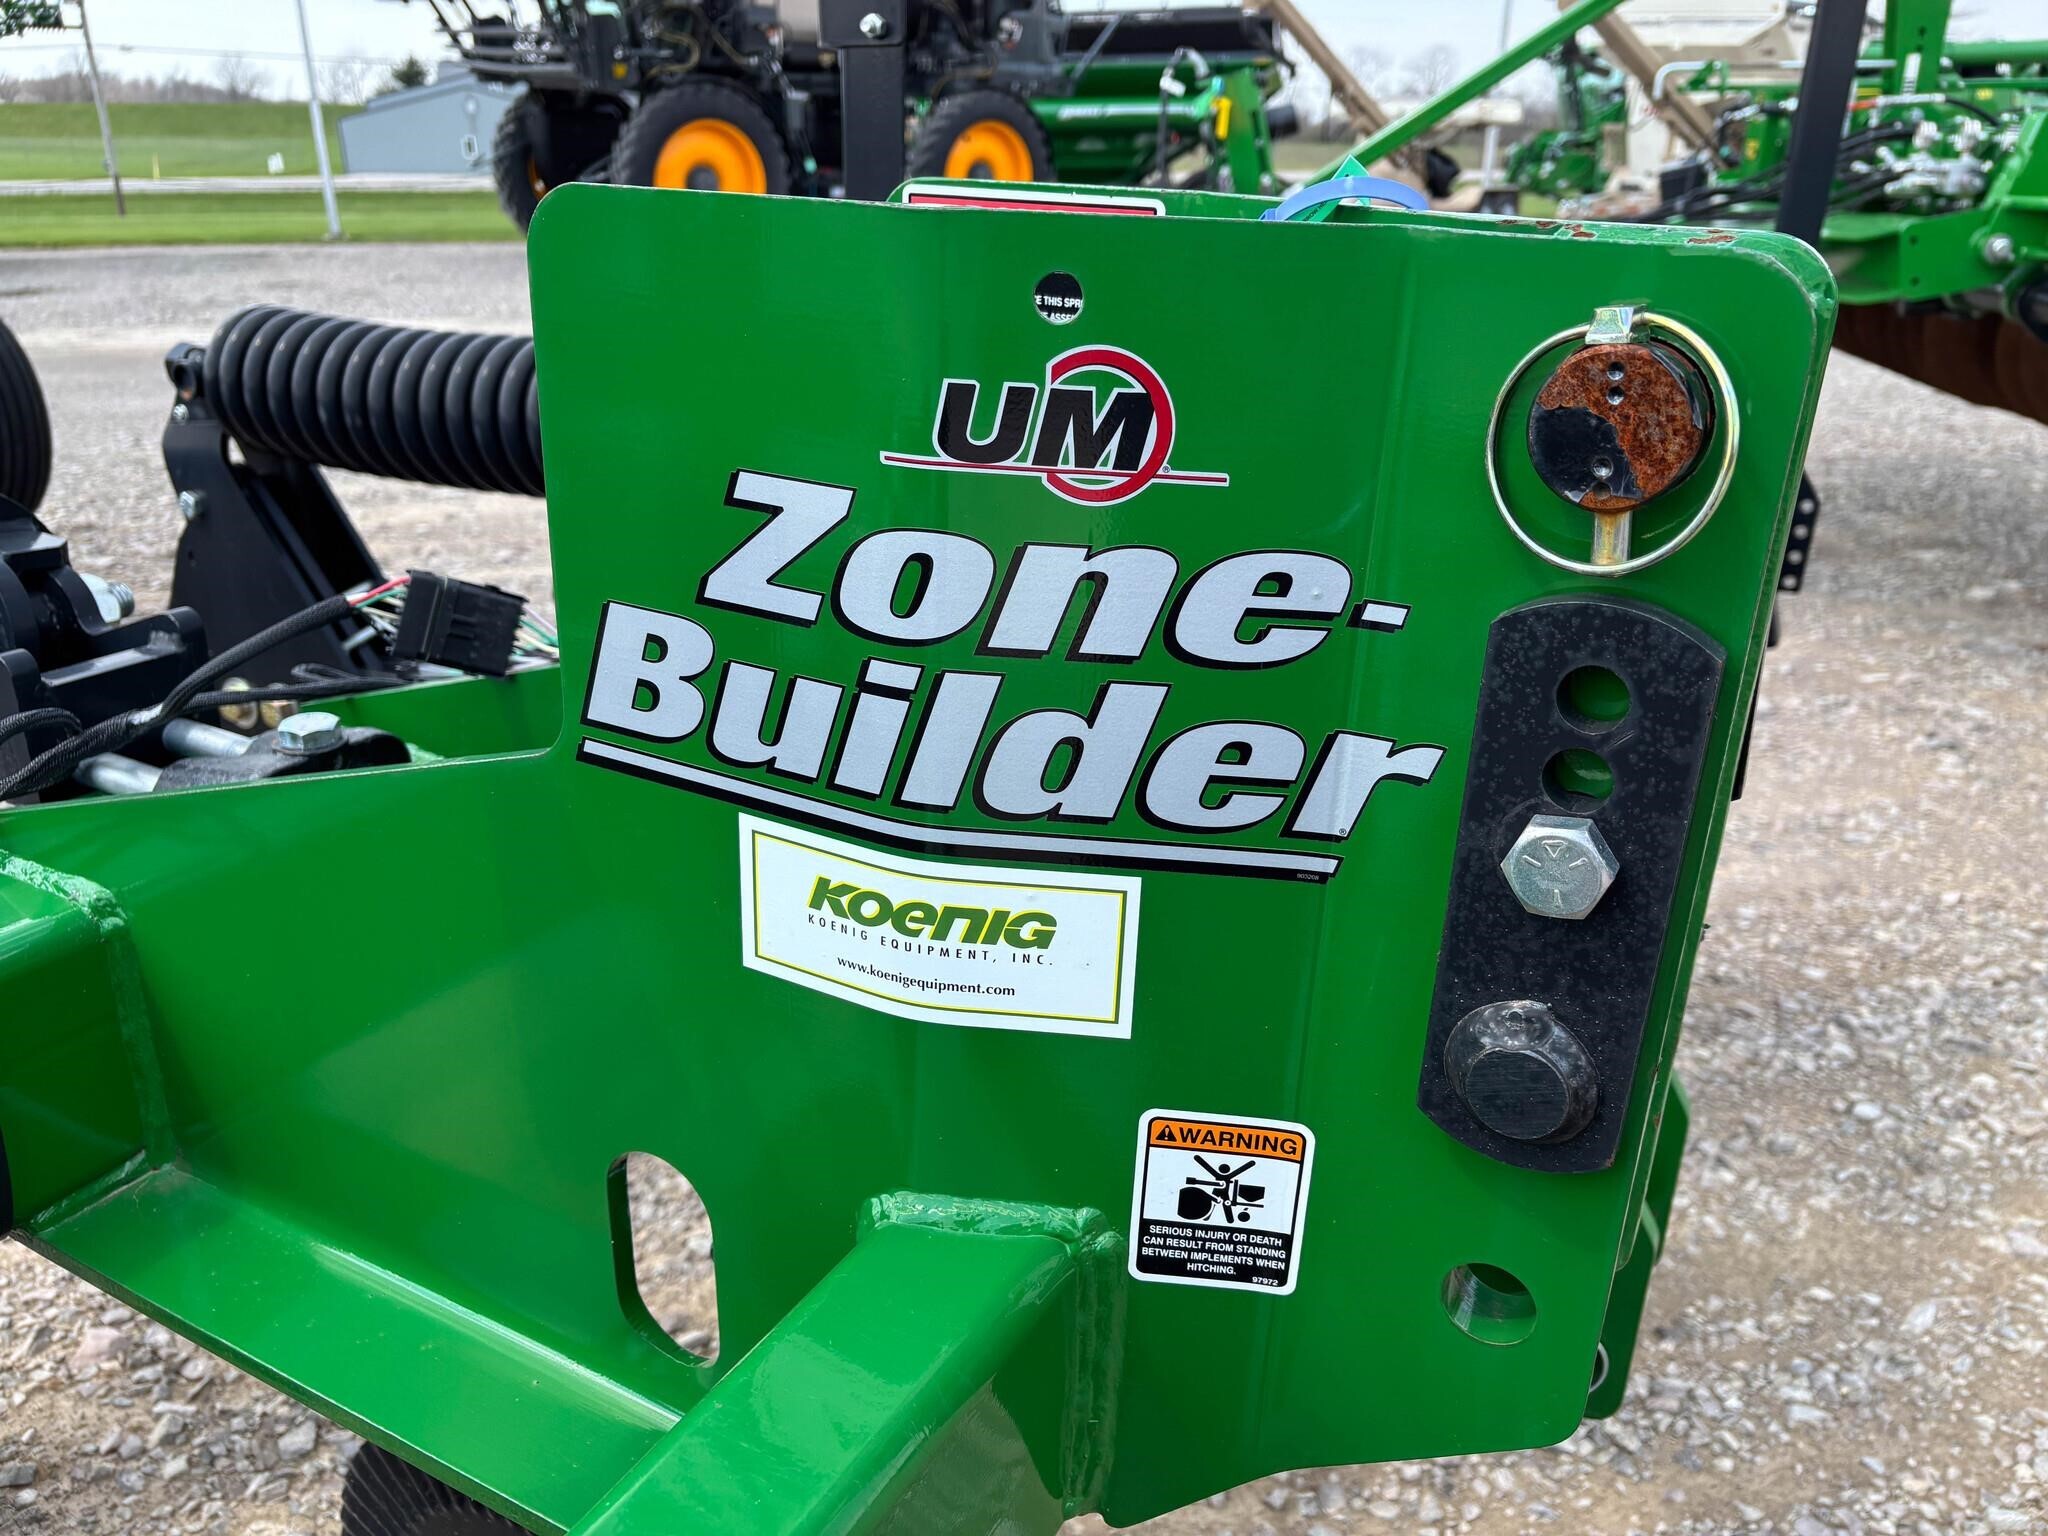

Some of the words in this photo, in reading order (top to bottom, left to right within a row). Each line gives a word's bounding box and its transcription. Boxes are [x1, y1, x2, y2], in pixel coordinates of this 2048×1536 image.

[1043, 295, 1063, 307] THIS
[698, 470, 1411, 669] Zone-
[581, 600, 1446, 842] Builder
[808, 914, 868, 940] KOENIG
[880, 936, 998, 963] EQUIPMENT,
[1012, 952, 1053, 966] INC.
[837, 956, 1016, 996] www.koenigequipment.com
[1179, 1127, 1297, 1156] WARNING
[1149, 1225, 1192, 1237] SERIOUS
[1195, 1228, 1231, 1241] INJURY
[1233, 1232, 1247, 1242] OR
[1250, 1234, 1282, 1246] DEATH
[1142, 1247, 1188, 1260] BETWEEN
[1190, 1252, 1253, 1266] IMPLEMENTS
[1255, 1258, 1285, 1270] WHEN
[1143, 1236, 1164, 1246] CAN
[1166, 1238, 1202, 1249] RESULT
[1205, 1242, 1234, 1252] FROM
[1236, 1244, 1286, 1259] STANDING
[1187, 1262, 1237, 1275] HITCHING.
[1252, 1276, 1279, 1286] 97972
